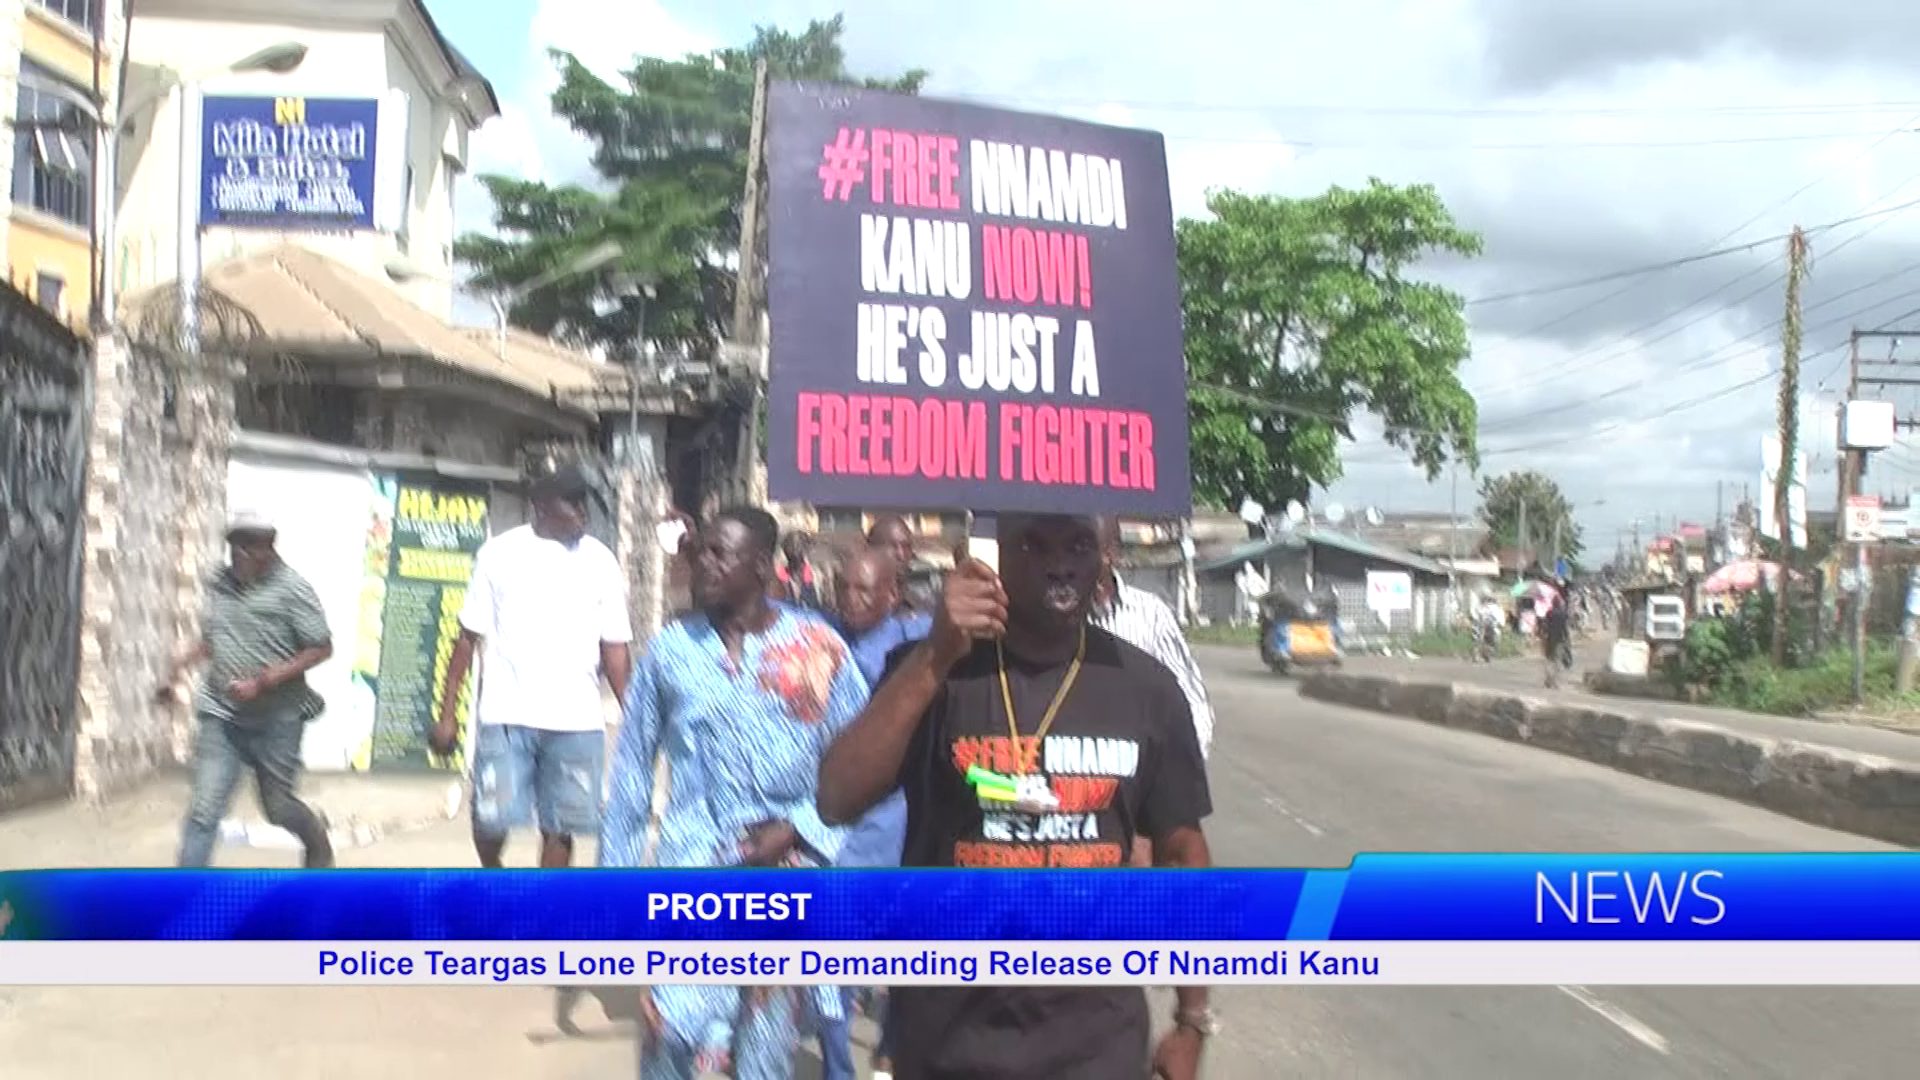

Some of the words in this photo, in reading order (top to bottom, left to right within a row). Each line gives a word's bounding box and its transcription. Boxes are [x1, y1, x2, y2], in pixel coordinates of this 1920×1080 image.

[818, 127, 960, 210] #FREE
[970, 139, 1127, 230] NNAMDI
[860, 213, 971, 300] KANU
[982, 224, 1092, 309] NOW!
[856, 302, 946, 387] HE'S
[959, 310, 1059, 393] JUST
[1071, 319, 1099, 397] A
[797, 392, 986, 480] FREEDOM
[1000, 402, 1155, 492] FIGHTER
[1082, 812, 1099, 839] A
